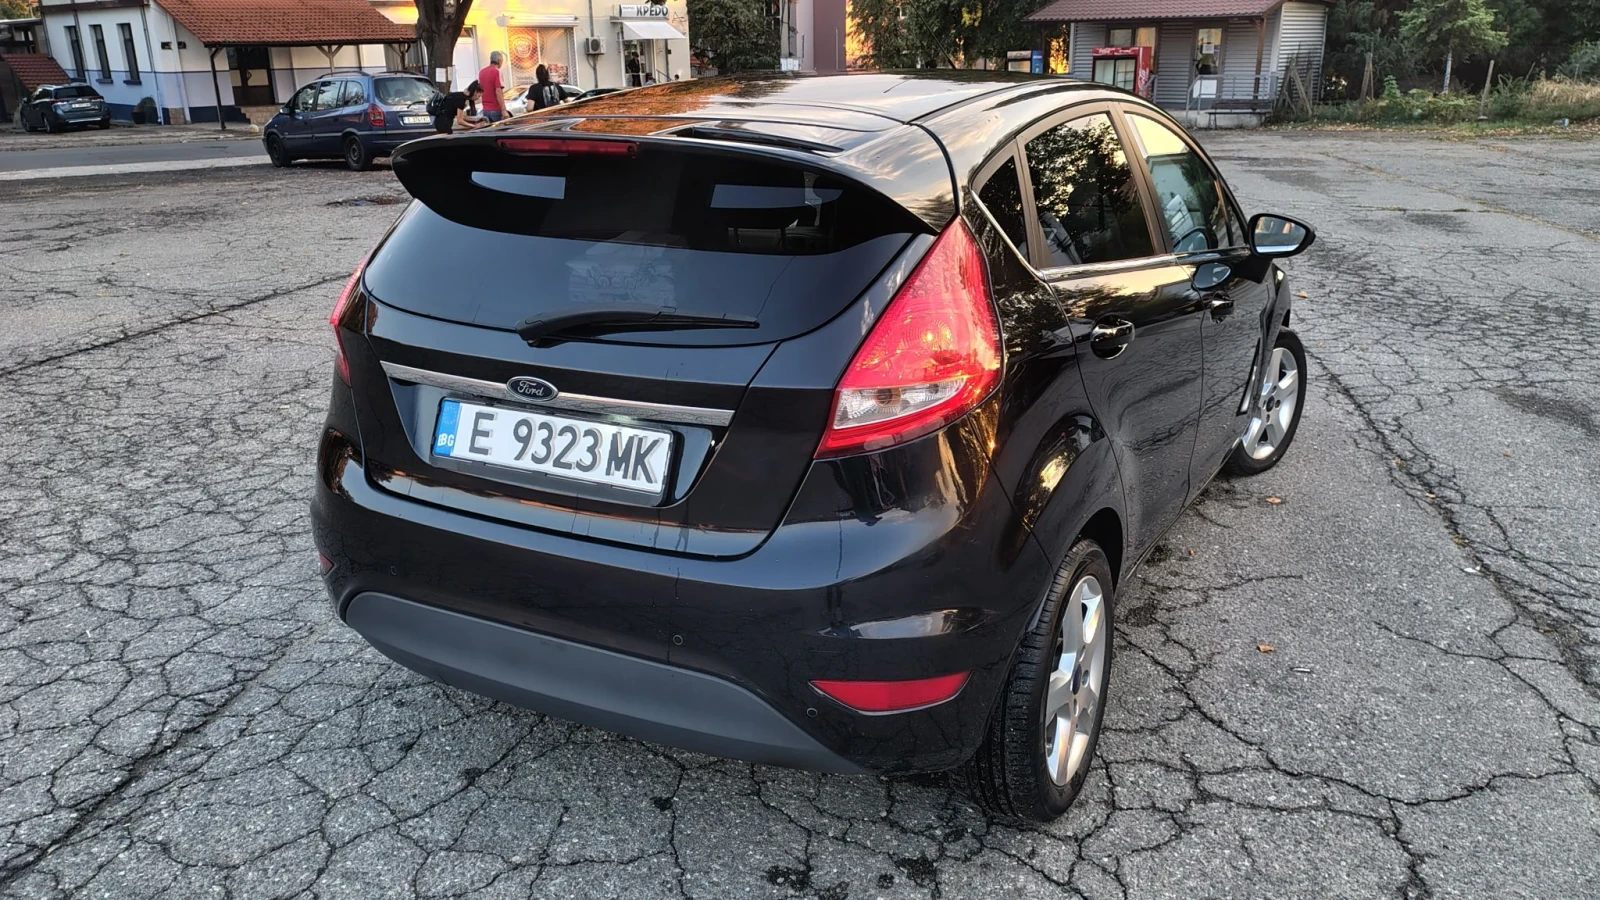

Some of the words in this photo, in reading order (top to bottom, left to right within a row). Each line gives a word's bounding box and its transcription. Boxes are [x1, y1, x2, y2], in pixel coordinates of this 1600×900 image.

[517, 380, 545, 397] Ford
[437, 432, 455, 447] BG
[468, 410, 496, 456] E
[513, 418, 601, 473] 9323
[605, 431, 662, 484] MK
